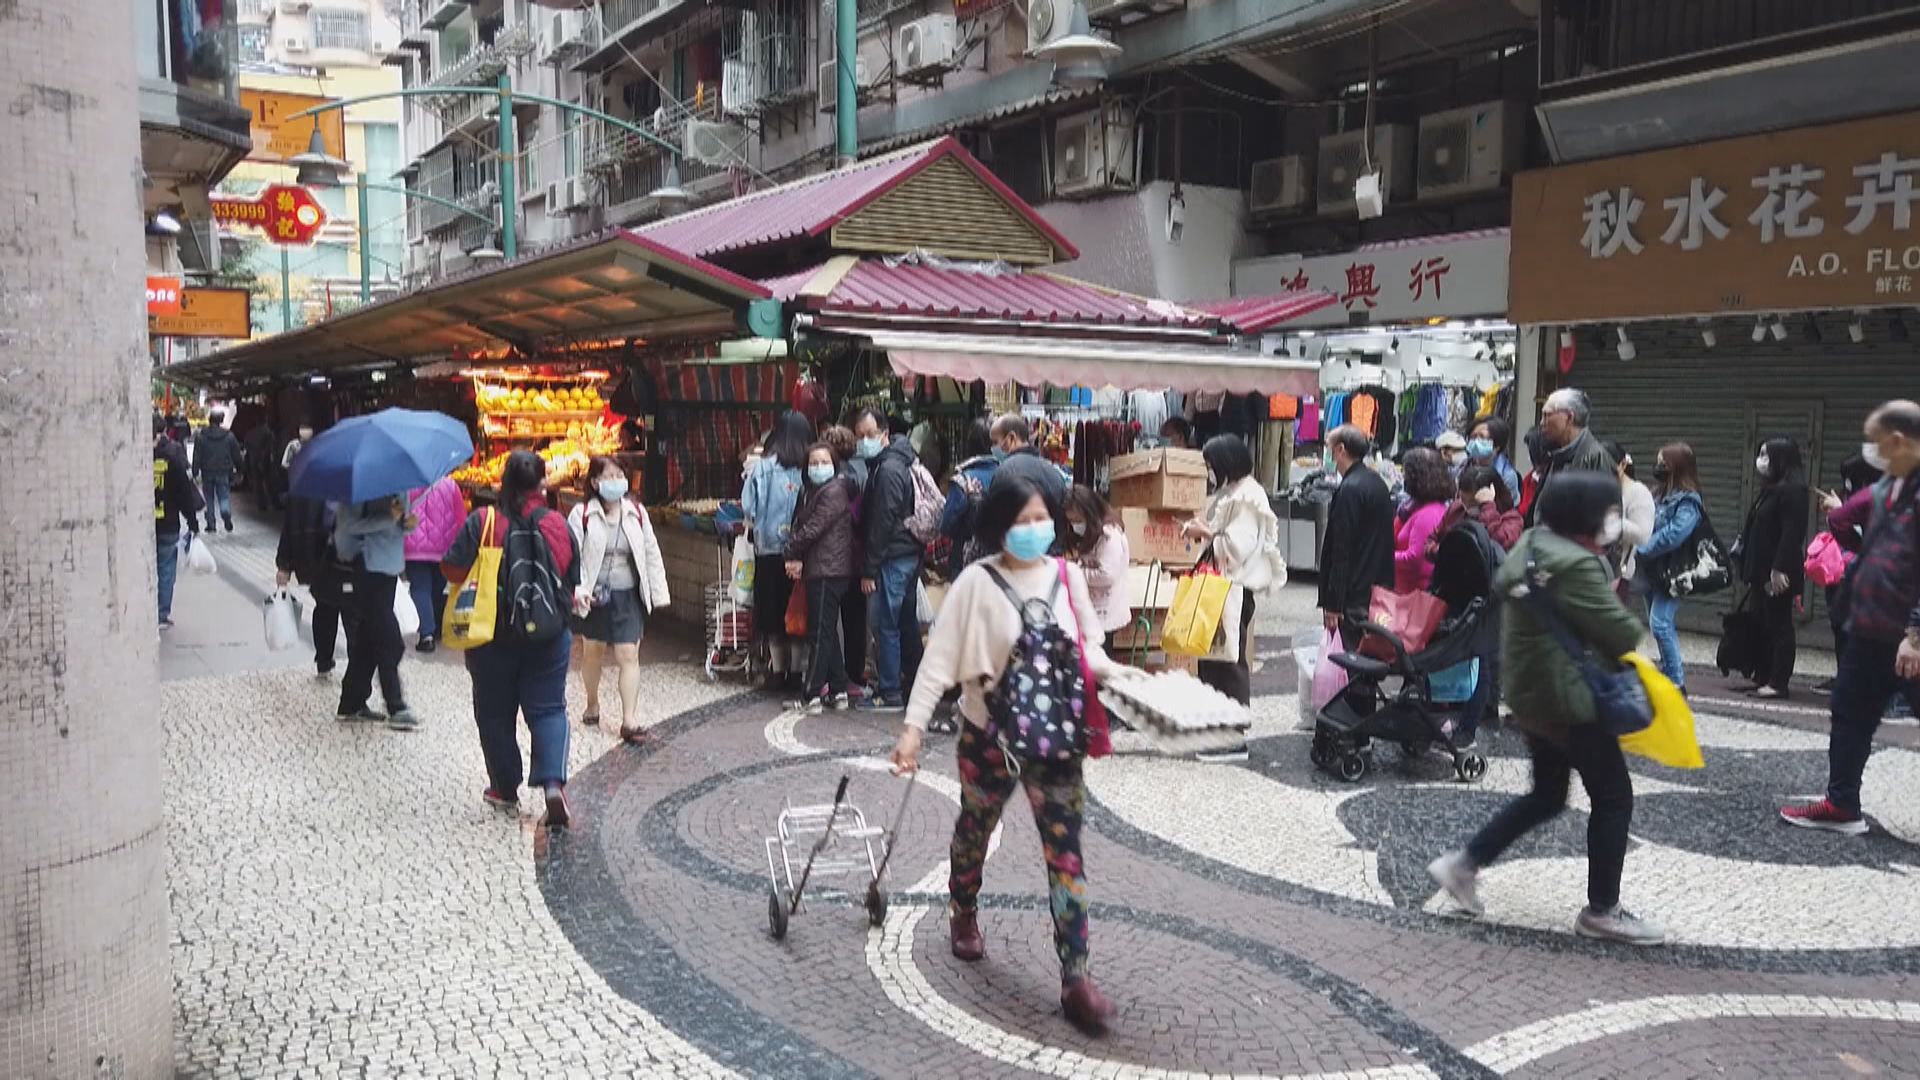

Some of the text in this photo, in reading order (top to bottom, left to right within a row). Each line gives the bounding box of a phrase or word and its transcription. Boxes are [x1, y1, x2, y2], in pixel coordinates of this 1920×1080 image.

[1580, 151, 1920, 259] 秋水花卉
[1787, 246, 1920, 278] A.O. FLO
[1874, 275, 1912, 294] 鮮花
